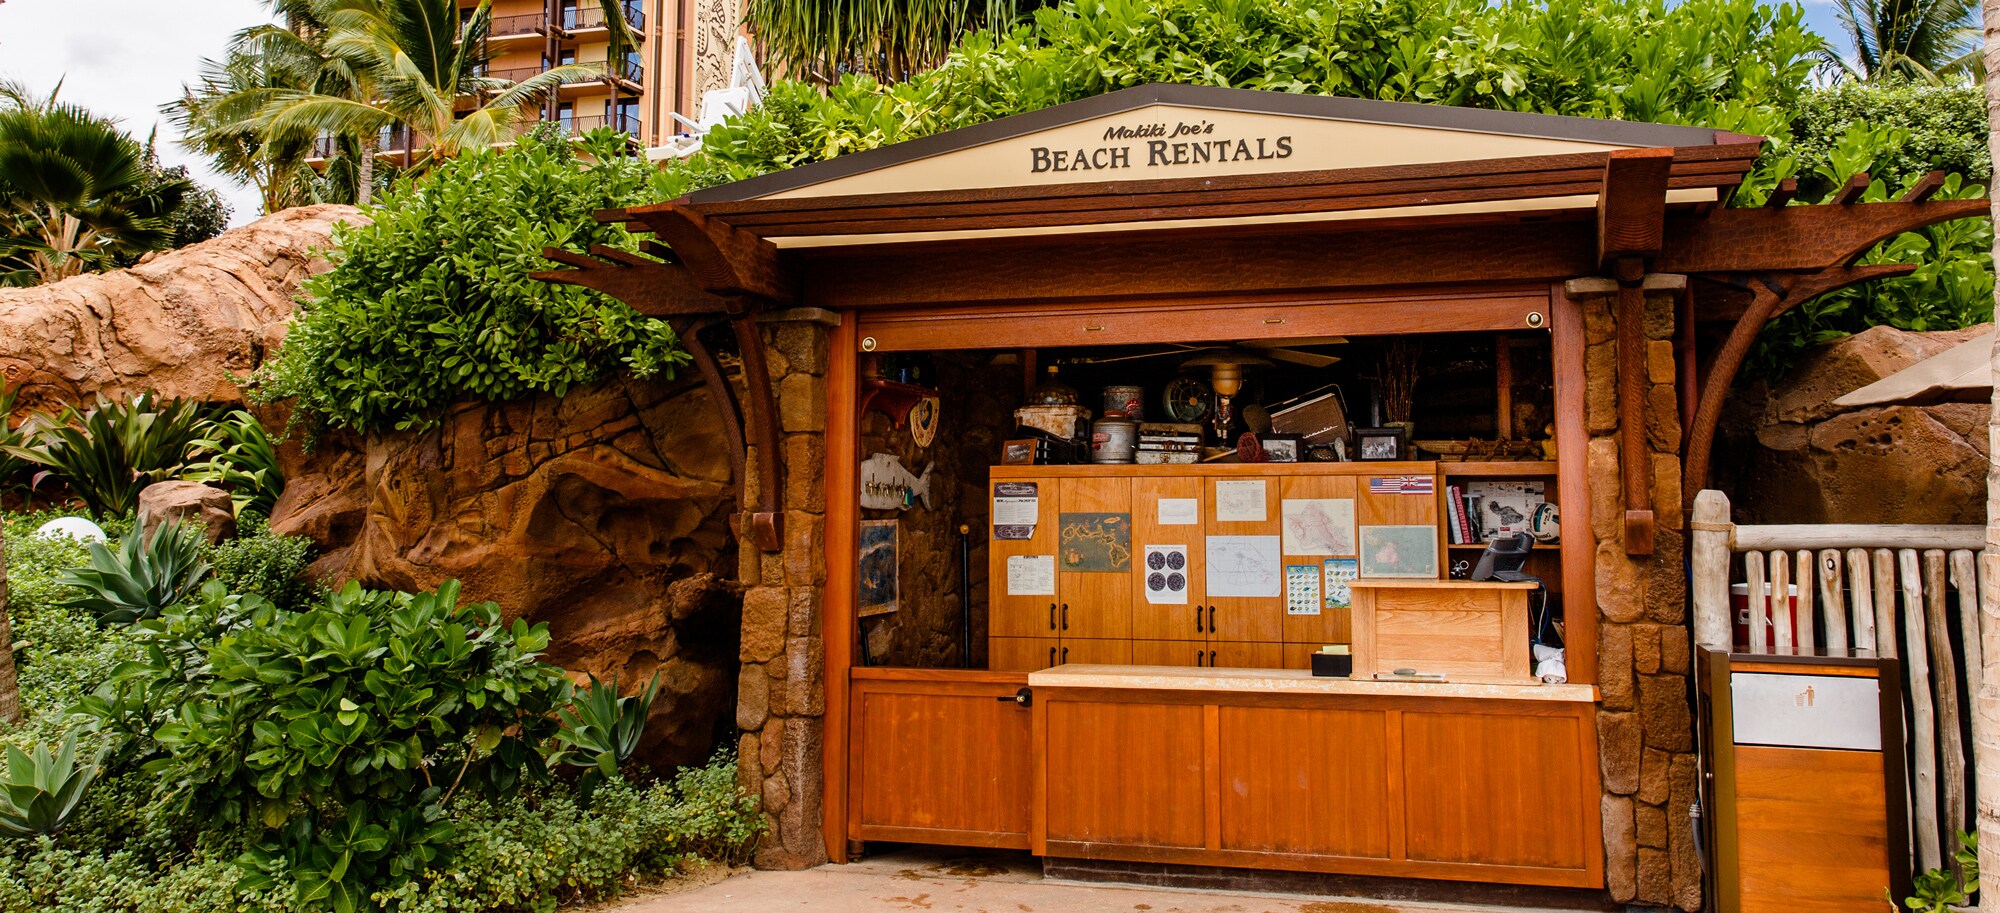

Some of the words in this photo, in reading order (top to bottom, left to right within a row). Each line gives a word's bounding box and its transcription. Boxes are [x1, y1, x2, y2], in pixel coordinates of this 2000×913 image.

[1103, 123, 1166, 141] Makiki
[1168, 120, 1214, 138] Joe's
[1030, 147, 1130, 173] BEACH
[1147, 136, 1293, 166] RENTALS
